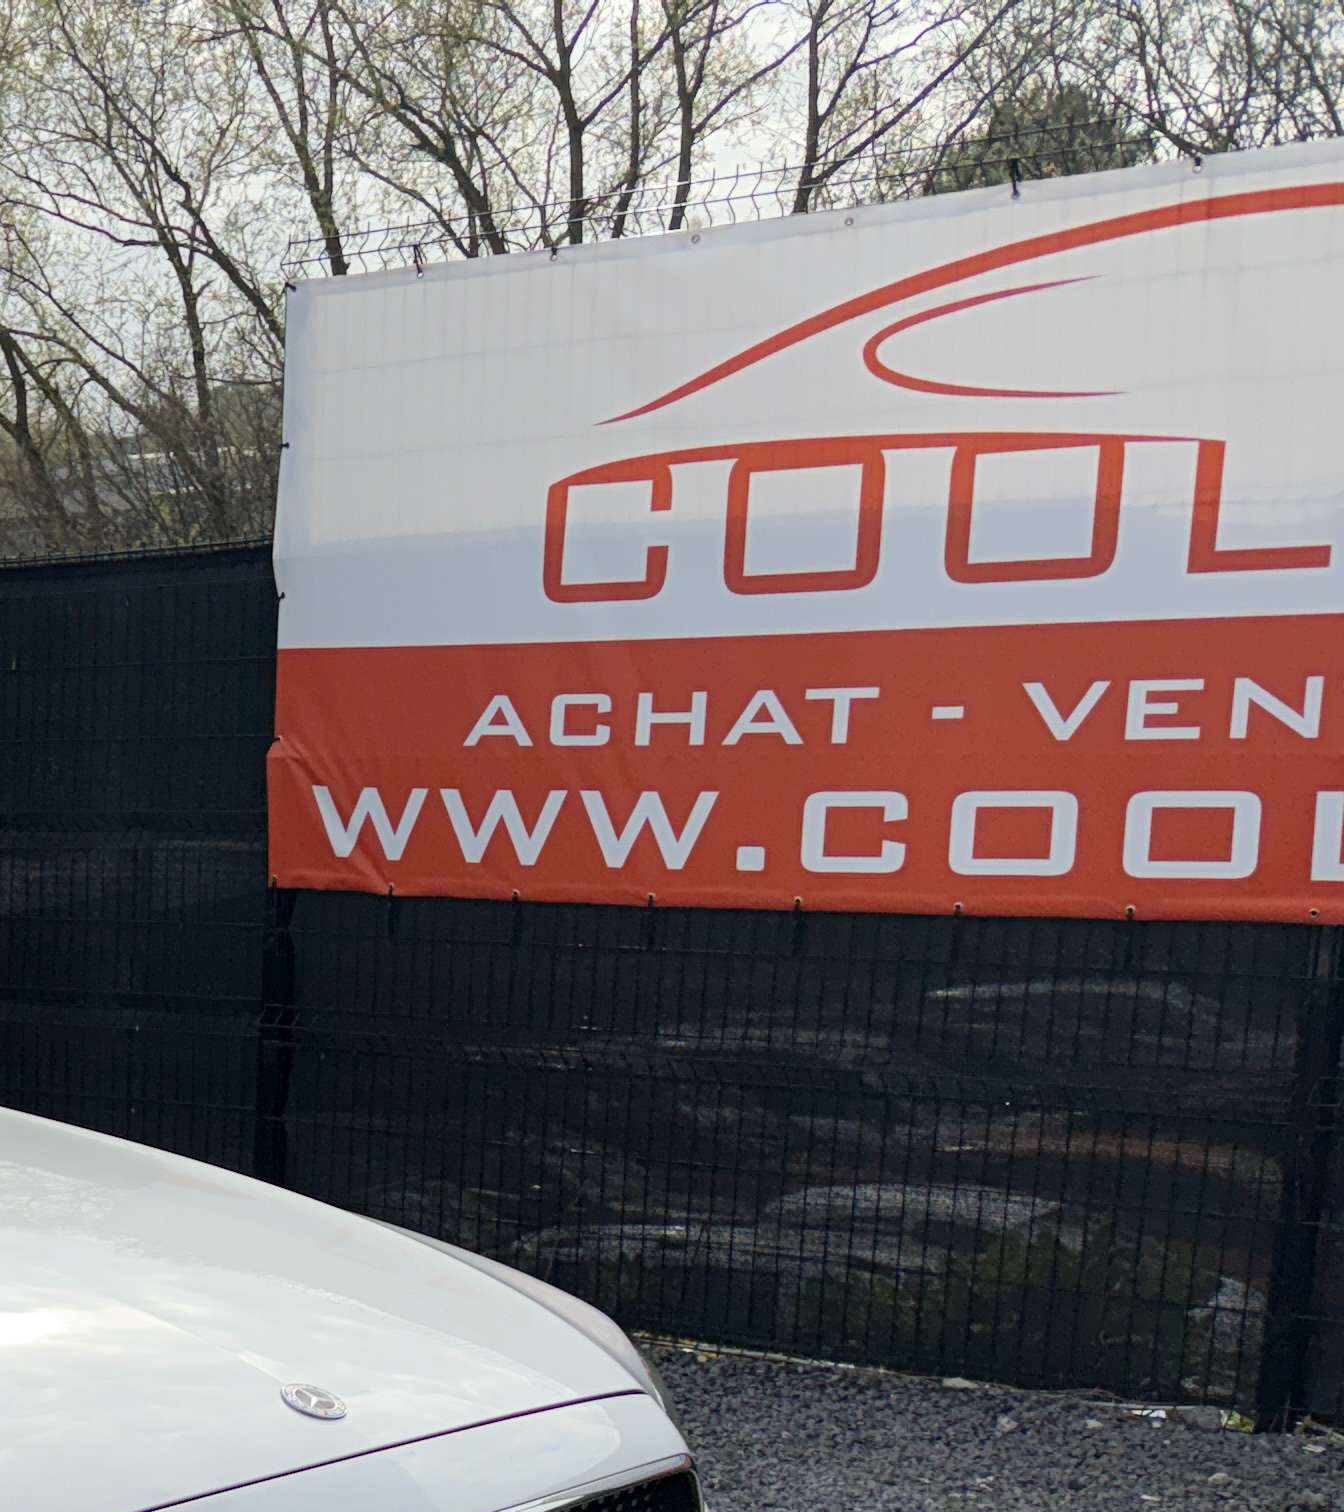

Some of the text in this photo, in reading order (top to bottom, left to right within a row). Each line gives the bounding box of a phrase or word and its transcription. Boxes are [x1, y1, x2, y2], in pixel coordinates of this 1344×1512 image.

[543, 431, 1331, 603] COOL
[463, 685, 880, 748] ACHAT
[1022, 675, 1325, 742] VEN
